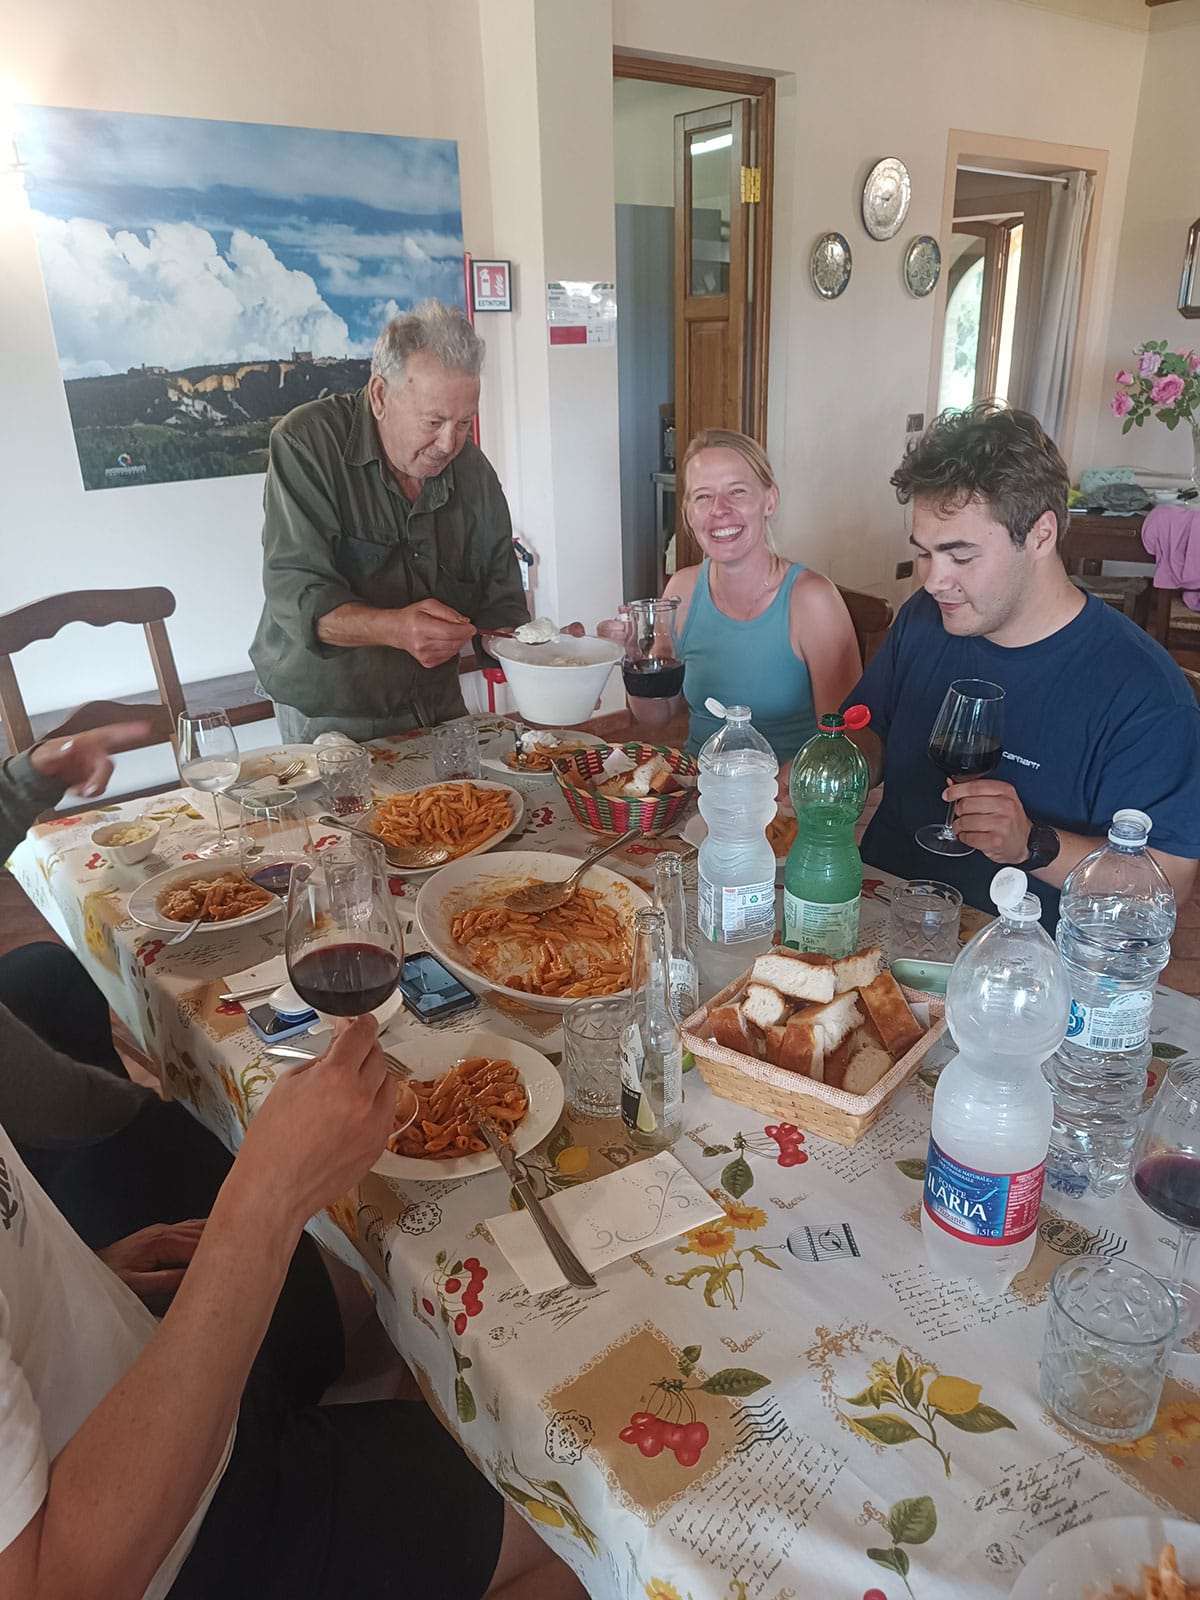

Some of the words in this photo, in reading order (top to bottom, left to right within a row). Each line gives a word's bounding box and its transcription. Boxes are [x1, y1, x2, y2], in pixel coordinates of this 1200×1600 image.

[477, 299, 507, 307] ESTINTORE
[1002, 751, 1041, 770] carhartt
[927, 1170, 988, 1222] ILARIA
[938, 1176, 967, 1199] FONTE
[935, 1201, 967, 1227] Frizzante
